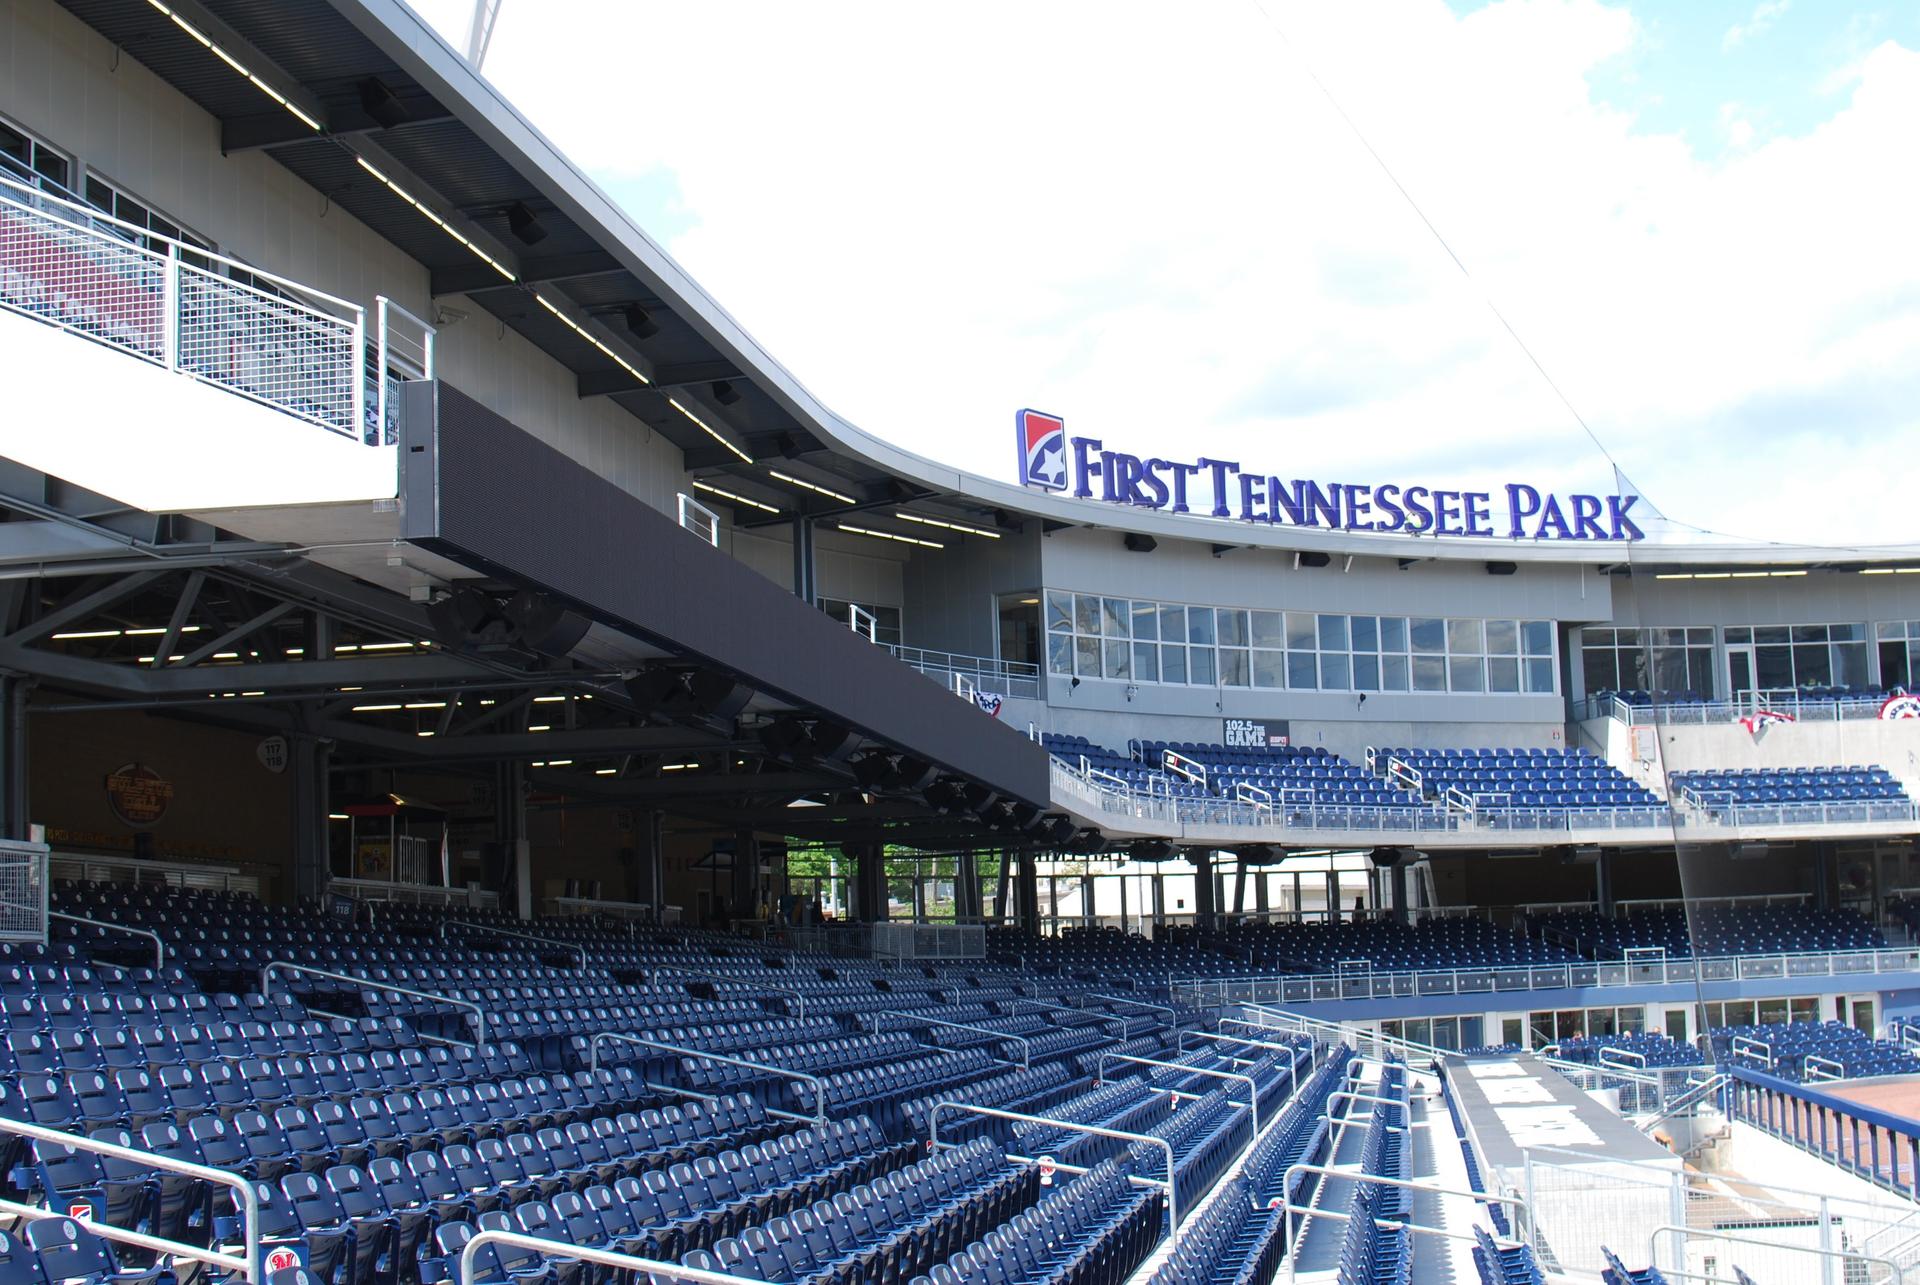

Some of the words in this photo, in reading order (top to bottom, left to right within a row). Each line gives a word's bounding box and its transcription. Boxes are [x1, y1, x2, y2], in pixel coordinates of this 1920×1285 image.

[1071, 437, 1199, 512] FIRST
[1197, 457, 1494, 537] TENNESSEE
[1505, 484, 1645, 540] PARK
[1225, 719, 1253, 731] 102.5
[1225, 730, 1266, 747] GAME
[265, 743, 281, 754] 117
[266, 756, 282, 767] 118
[335, 905, 350, 915] 118
